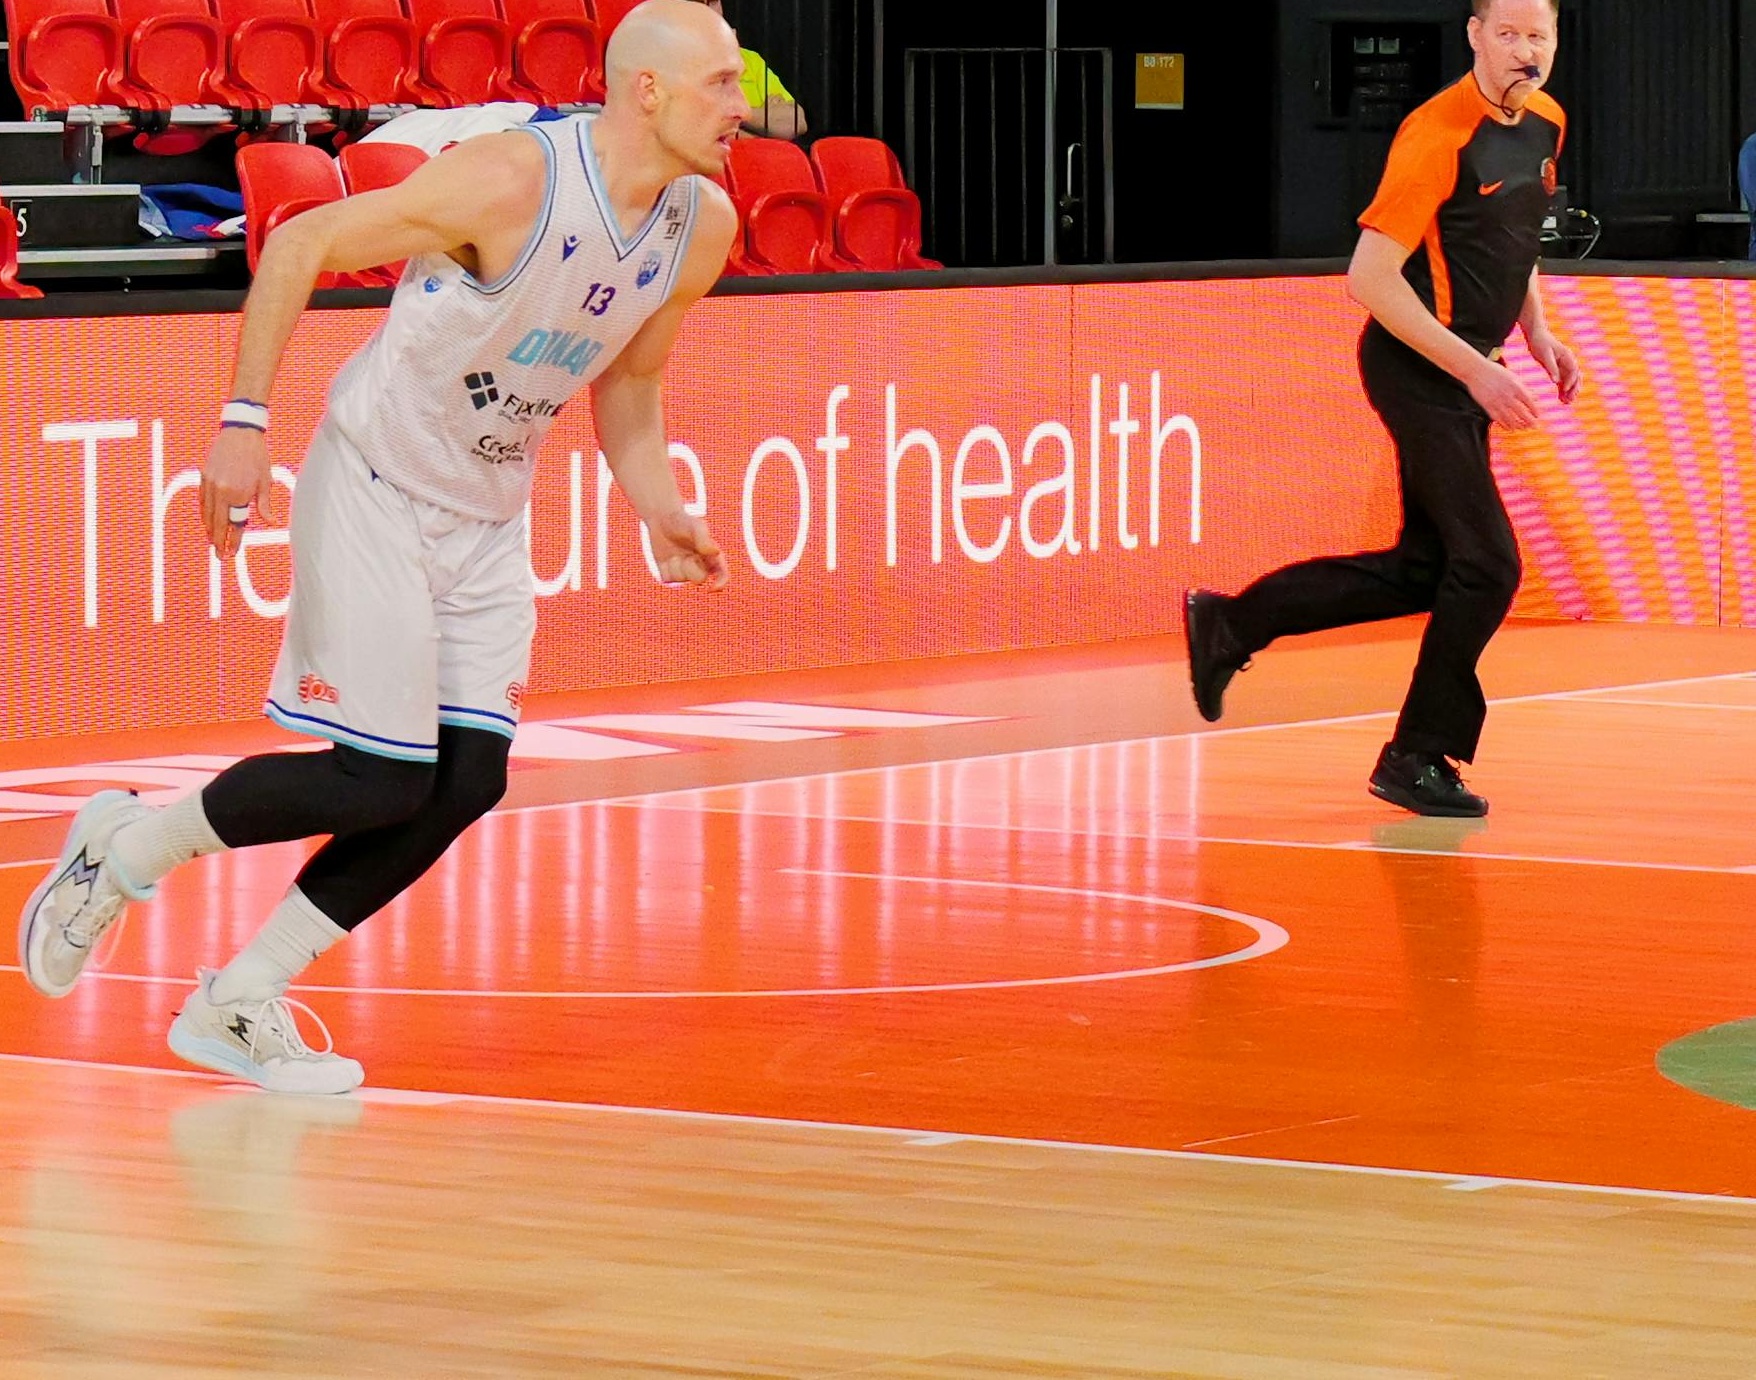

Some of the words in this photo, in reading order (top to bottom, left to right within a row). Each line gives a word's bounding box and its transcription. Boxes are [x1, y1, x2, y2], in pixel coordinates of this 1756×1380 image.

[579, 282, 616, 316] 13
[743, 384, 850, 580] of
[885, 370, 1202, 566] health
